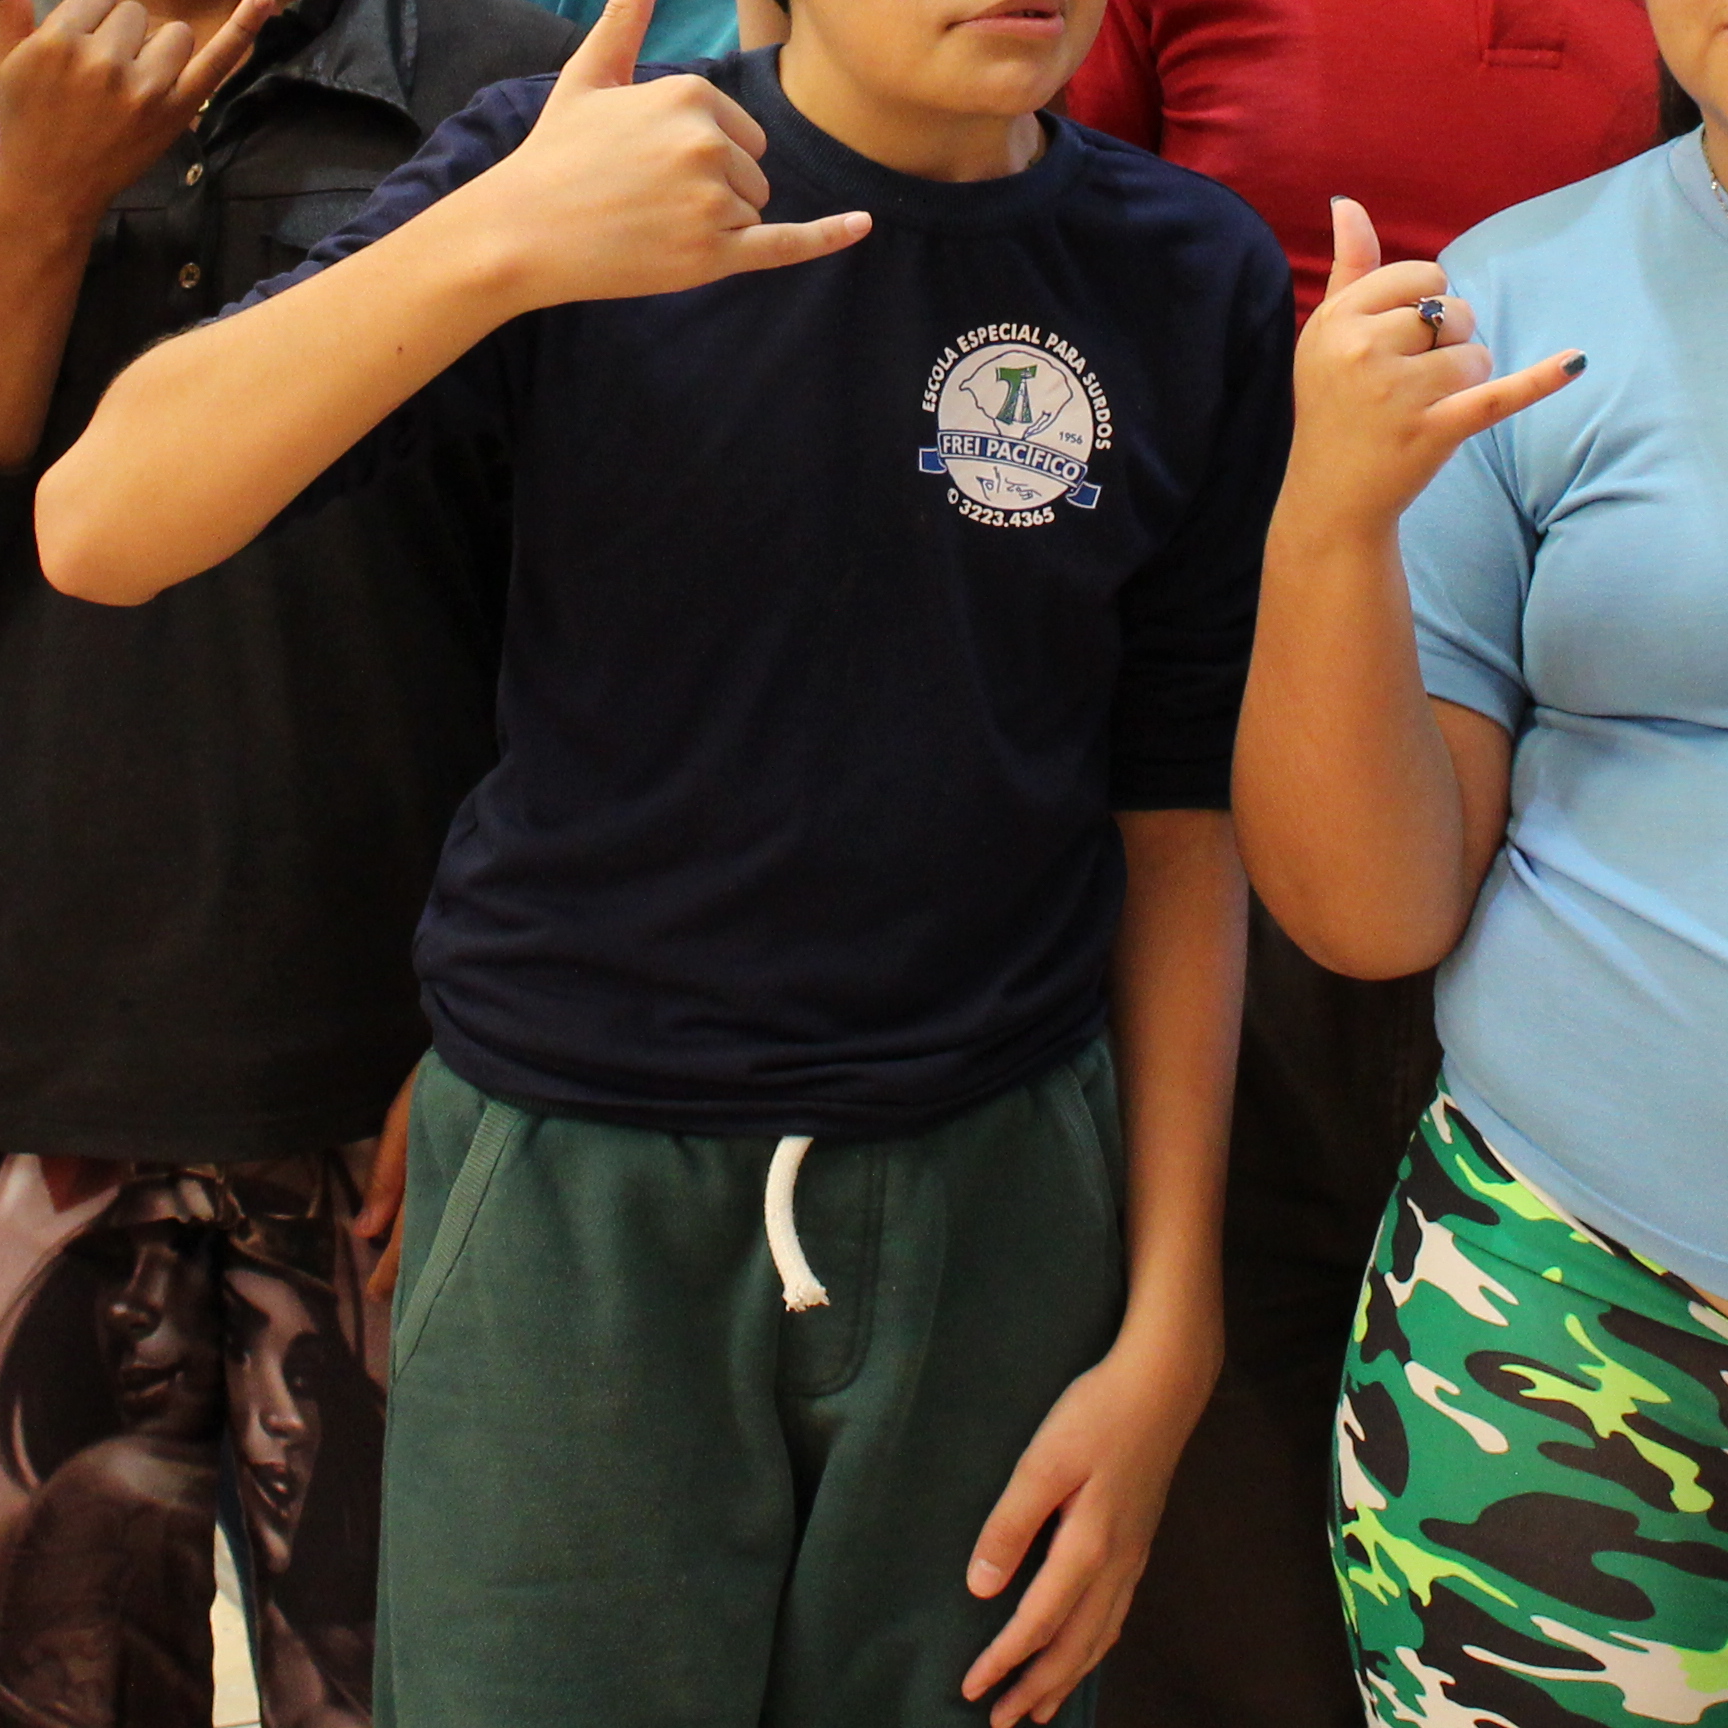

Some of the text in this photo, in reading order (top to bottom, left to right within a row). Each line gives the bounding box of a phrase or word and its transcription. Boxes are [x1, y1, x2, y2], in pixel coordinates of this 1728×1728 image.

[922, 323, 1113, 450] ESCOLA ESPECIAL PARA SURDOS
[1059, 431, 1083, 445] 1956
[942, 435, 1080, 481] FREI PACÍFICO
[959, 499, 1055, 528] 3223.4365
